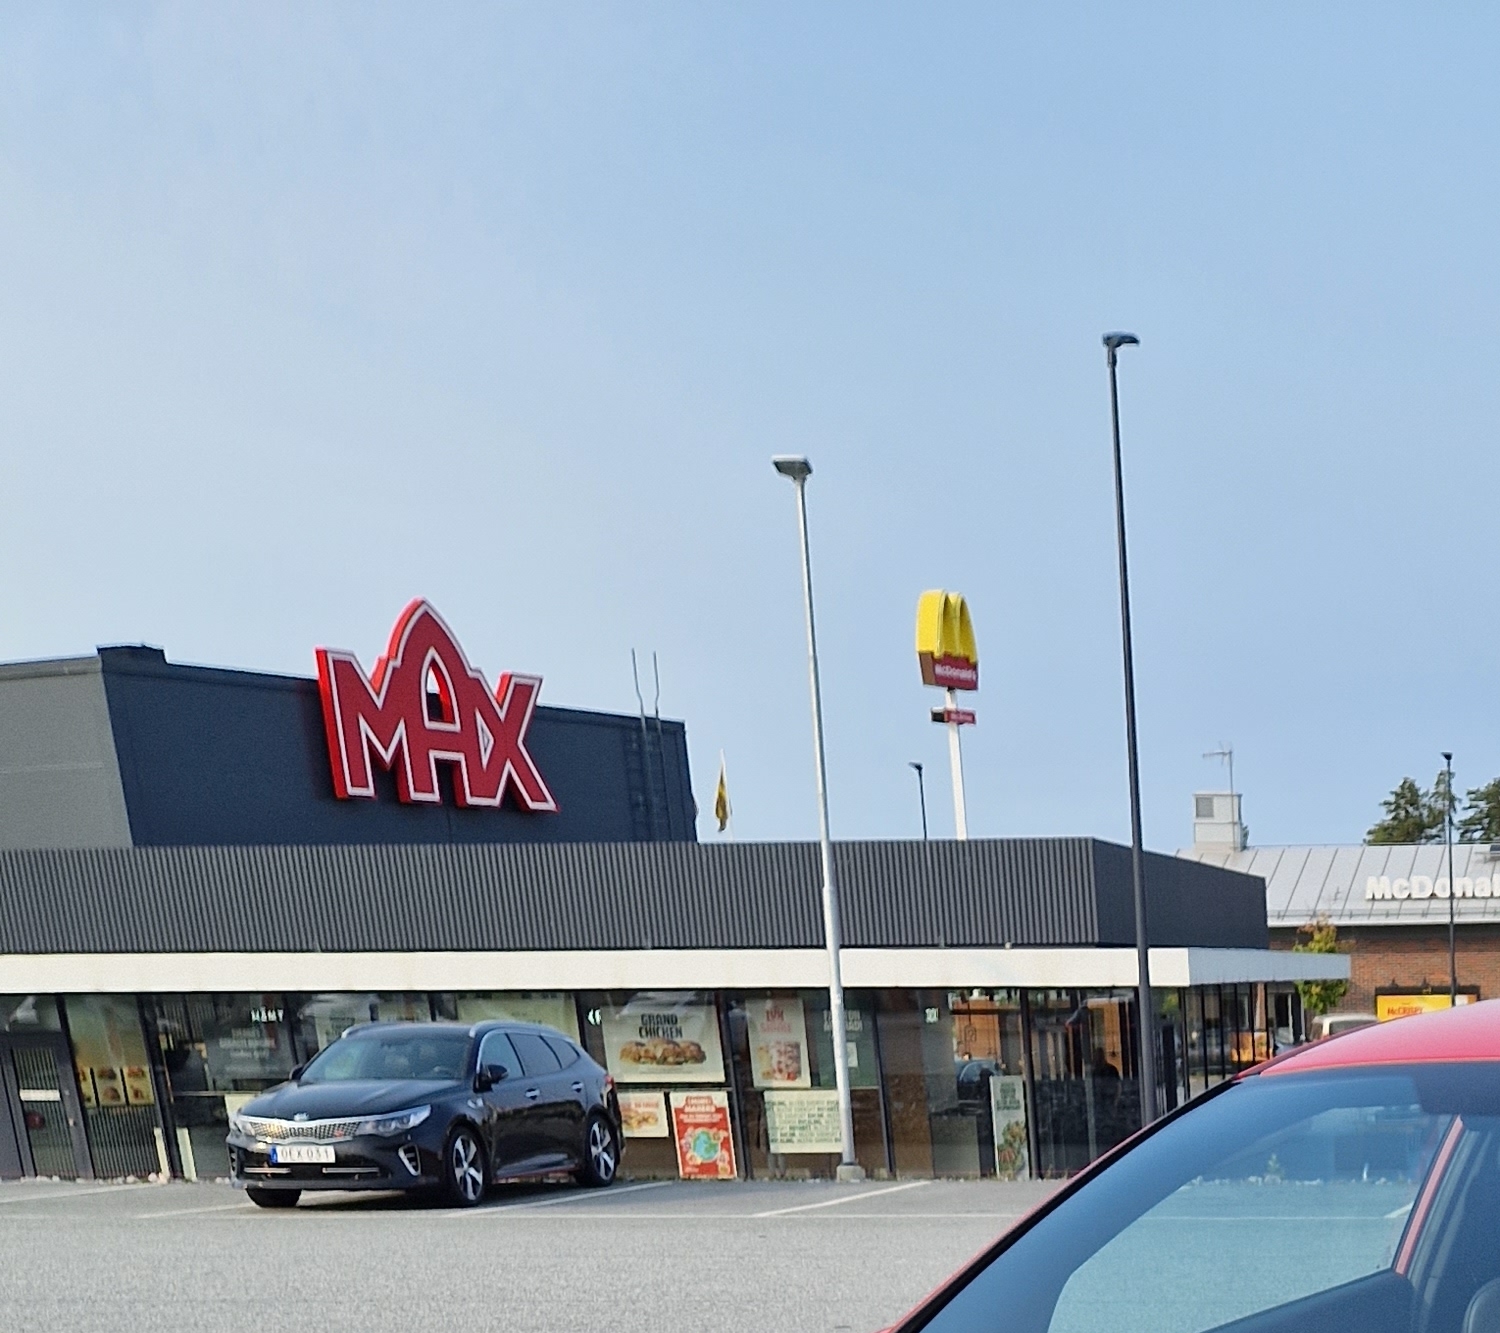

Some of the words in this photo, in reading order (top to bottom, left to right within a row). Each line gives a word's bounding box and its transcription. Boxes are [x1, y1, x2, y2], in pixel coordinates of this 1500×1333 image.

[315, 597, 557, 812] MAX
[641, 1013, 678, 1026] GRAND
[639, 1026, 683, 1039] CHICKEN
